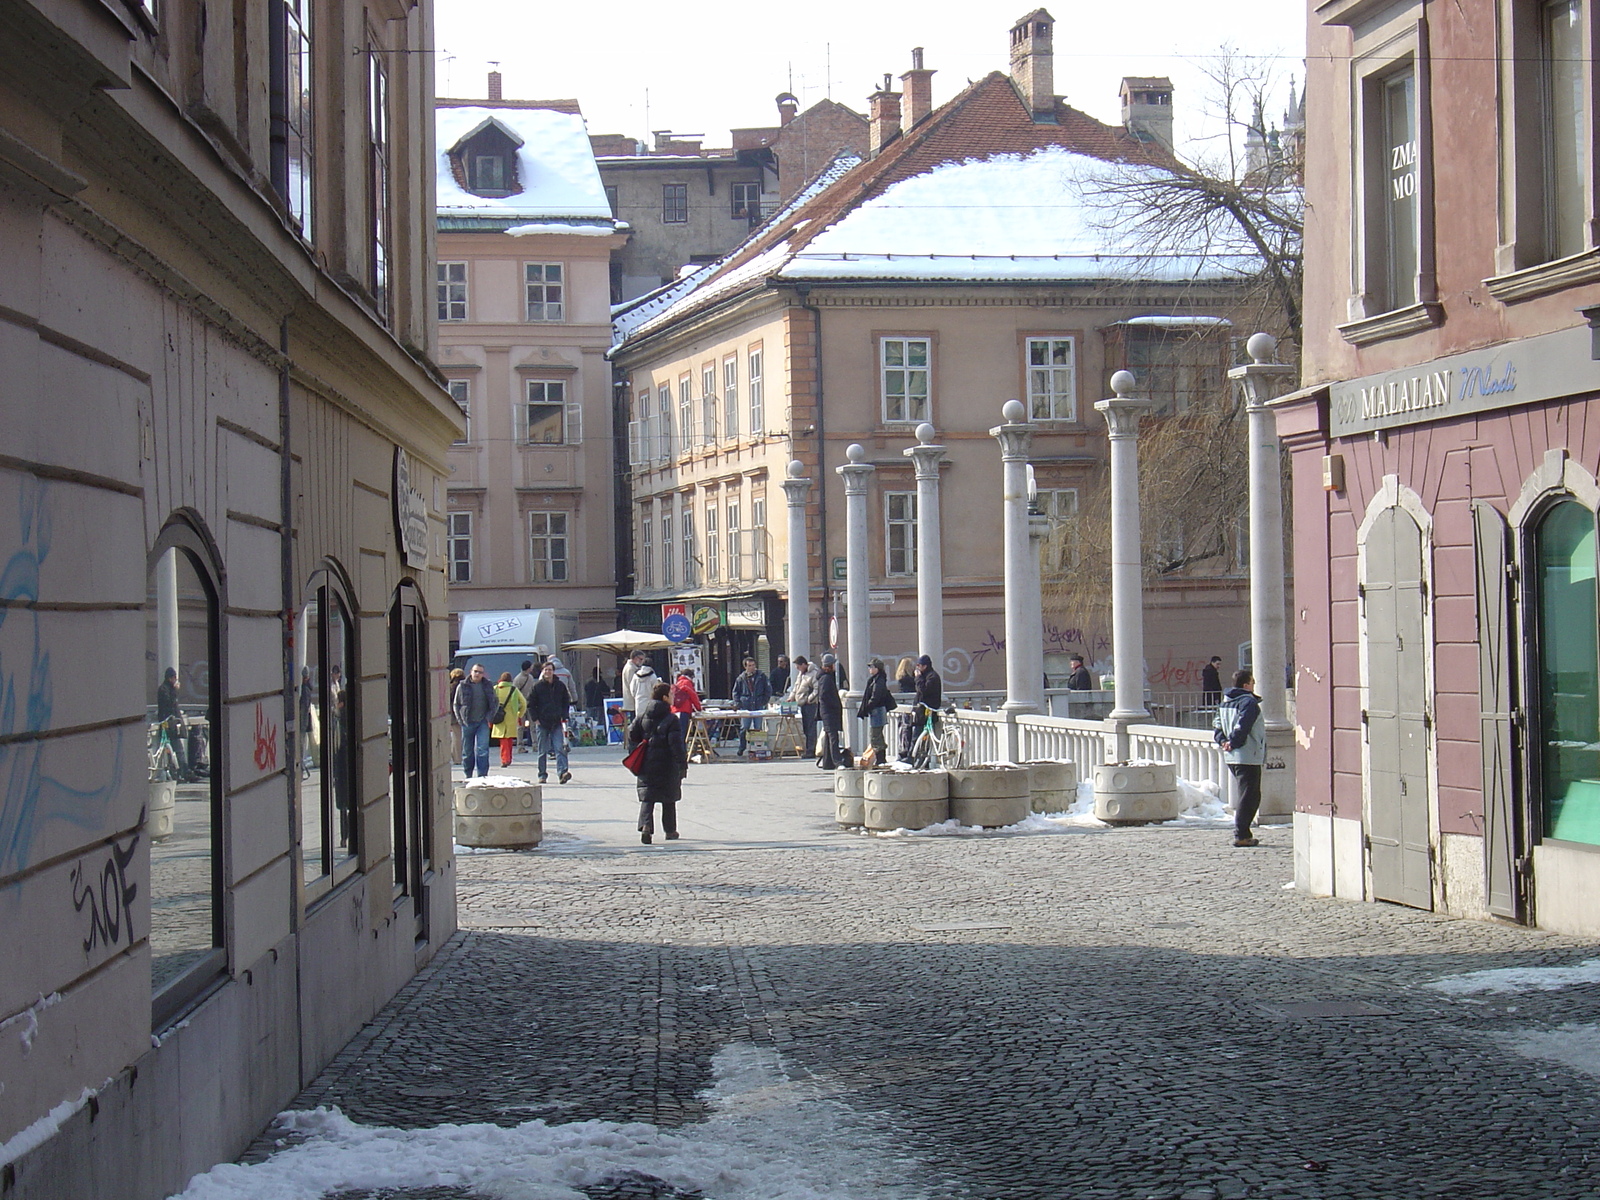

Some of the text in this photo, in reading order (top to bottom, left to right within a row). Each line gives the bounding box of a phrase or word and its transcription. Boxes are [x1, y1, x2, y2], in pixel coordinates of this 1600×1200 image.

[1361, 360, 1517, 420] MALALAN Mladi
[480, 618, 518, 635] VPK
